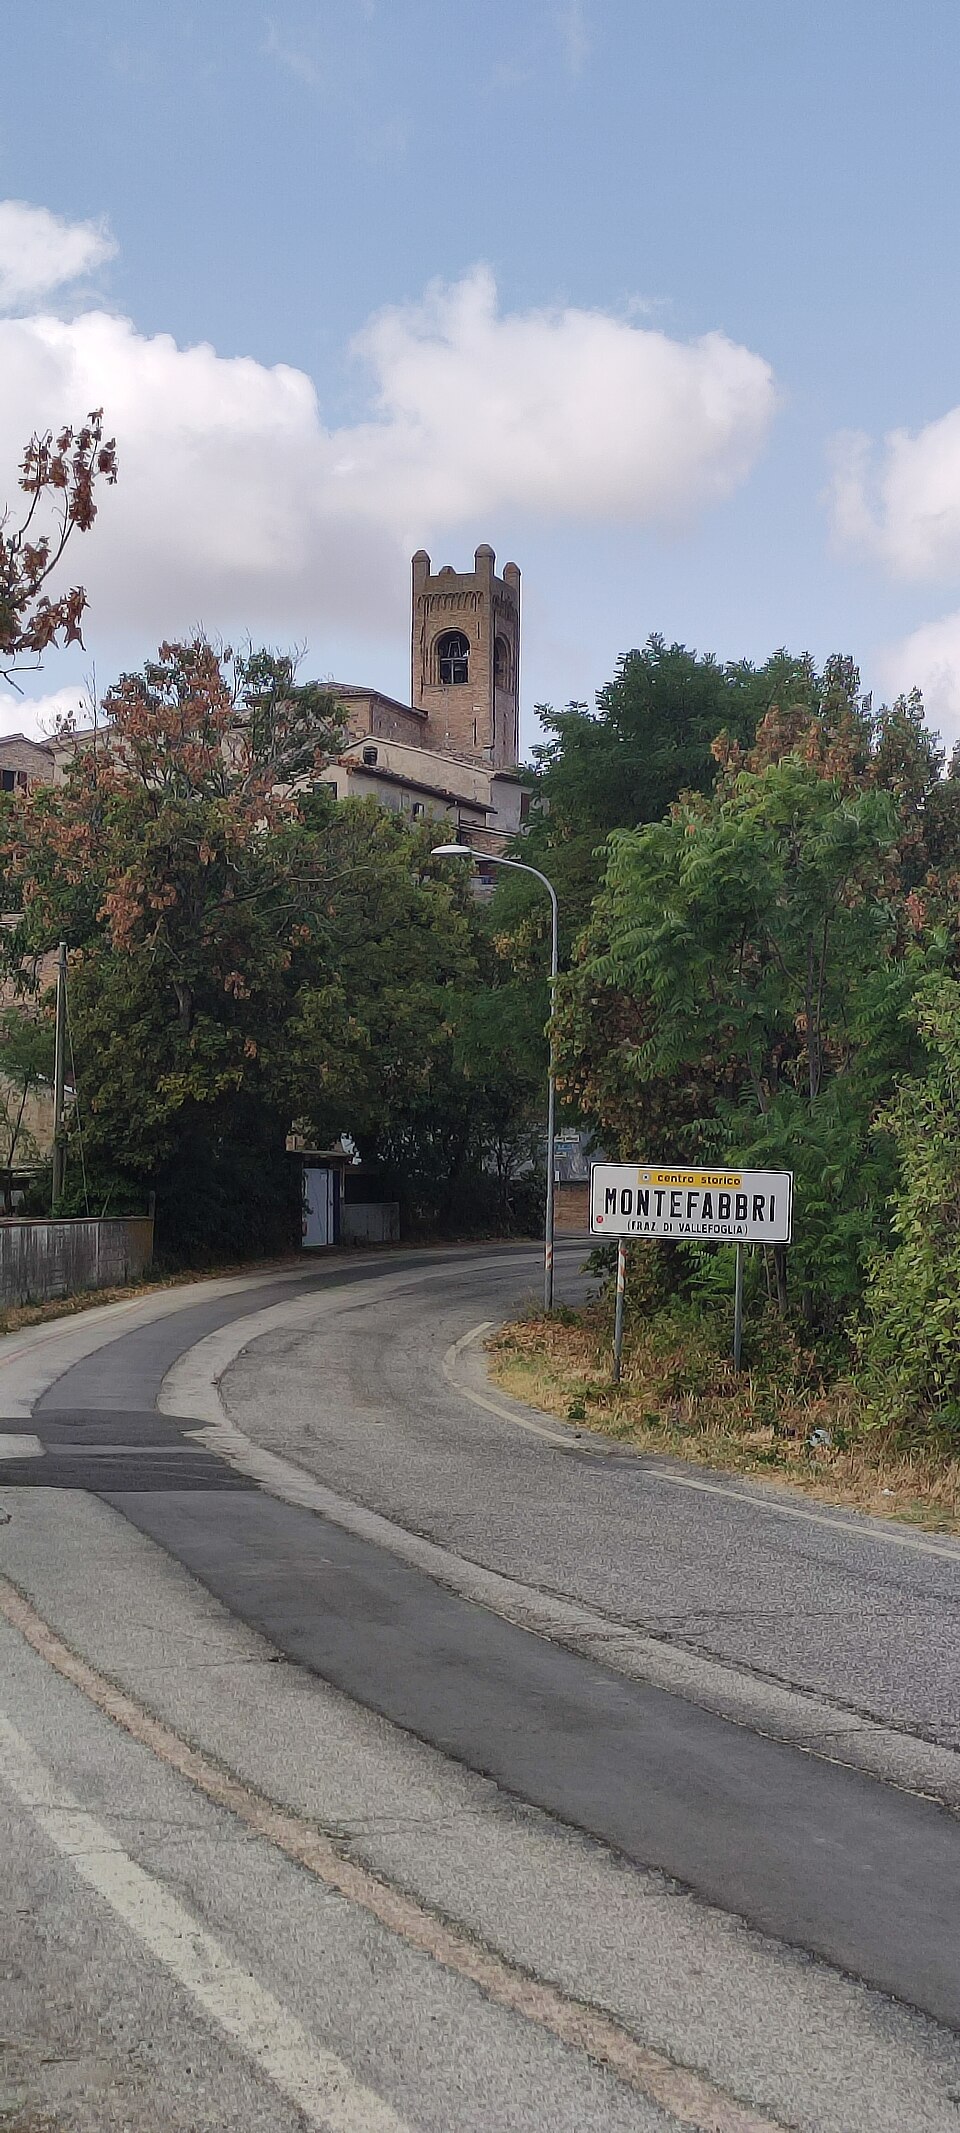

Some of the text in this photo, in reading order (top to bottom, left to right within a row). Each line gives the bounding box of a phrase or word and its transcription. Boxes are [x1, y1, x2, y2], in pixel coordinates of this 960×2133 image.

[657, 1173, 741, 1186] centro storico
[604, 1187, 775, 1222] MONTEFABBRI
[663, 1222, 673, 1232] DI
[679, 1222, 748, 1236] VALLEFOGLIA)
